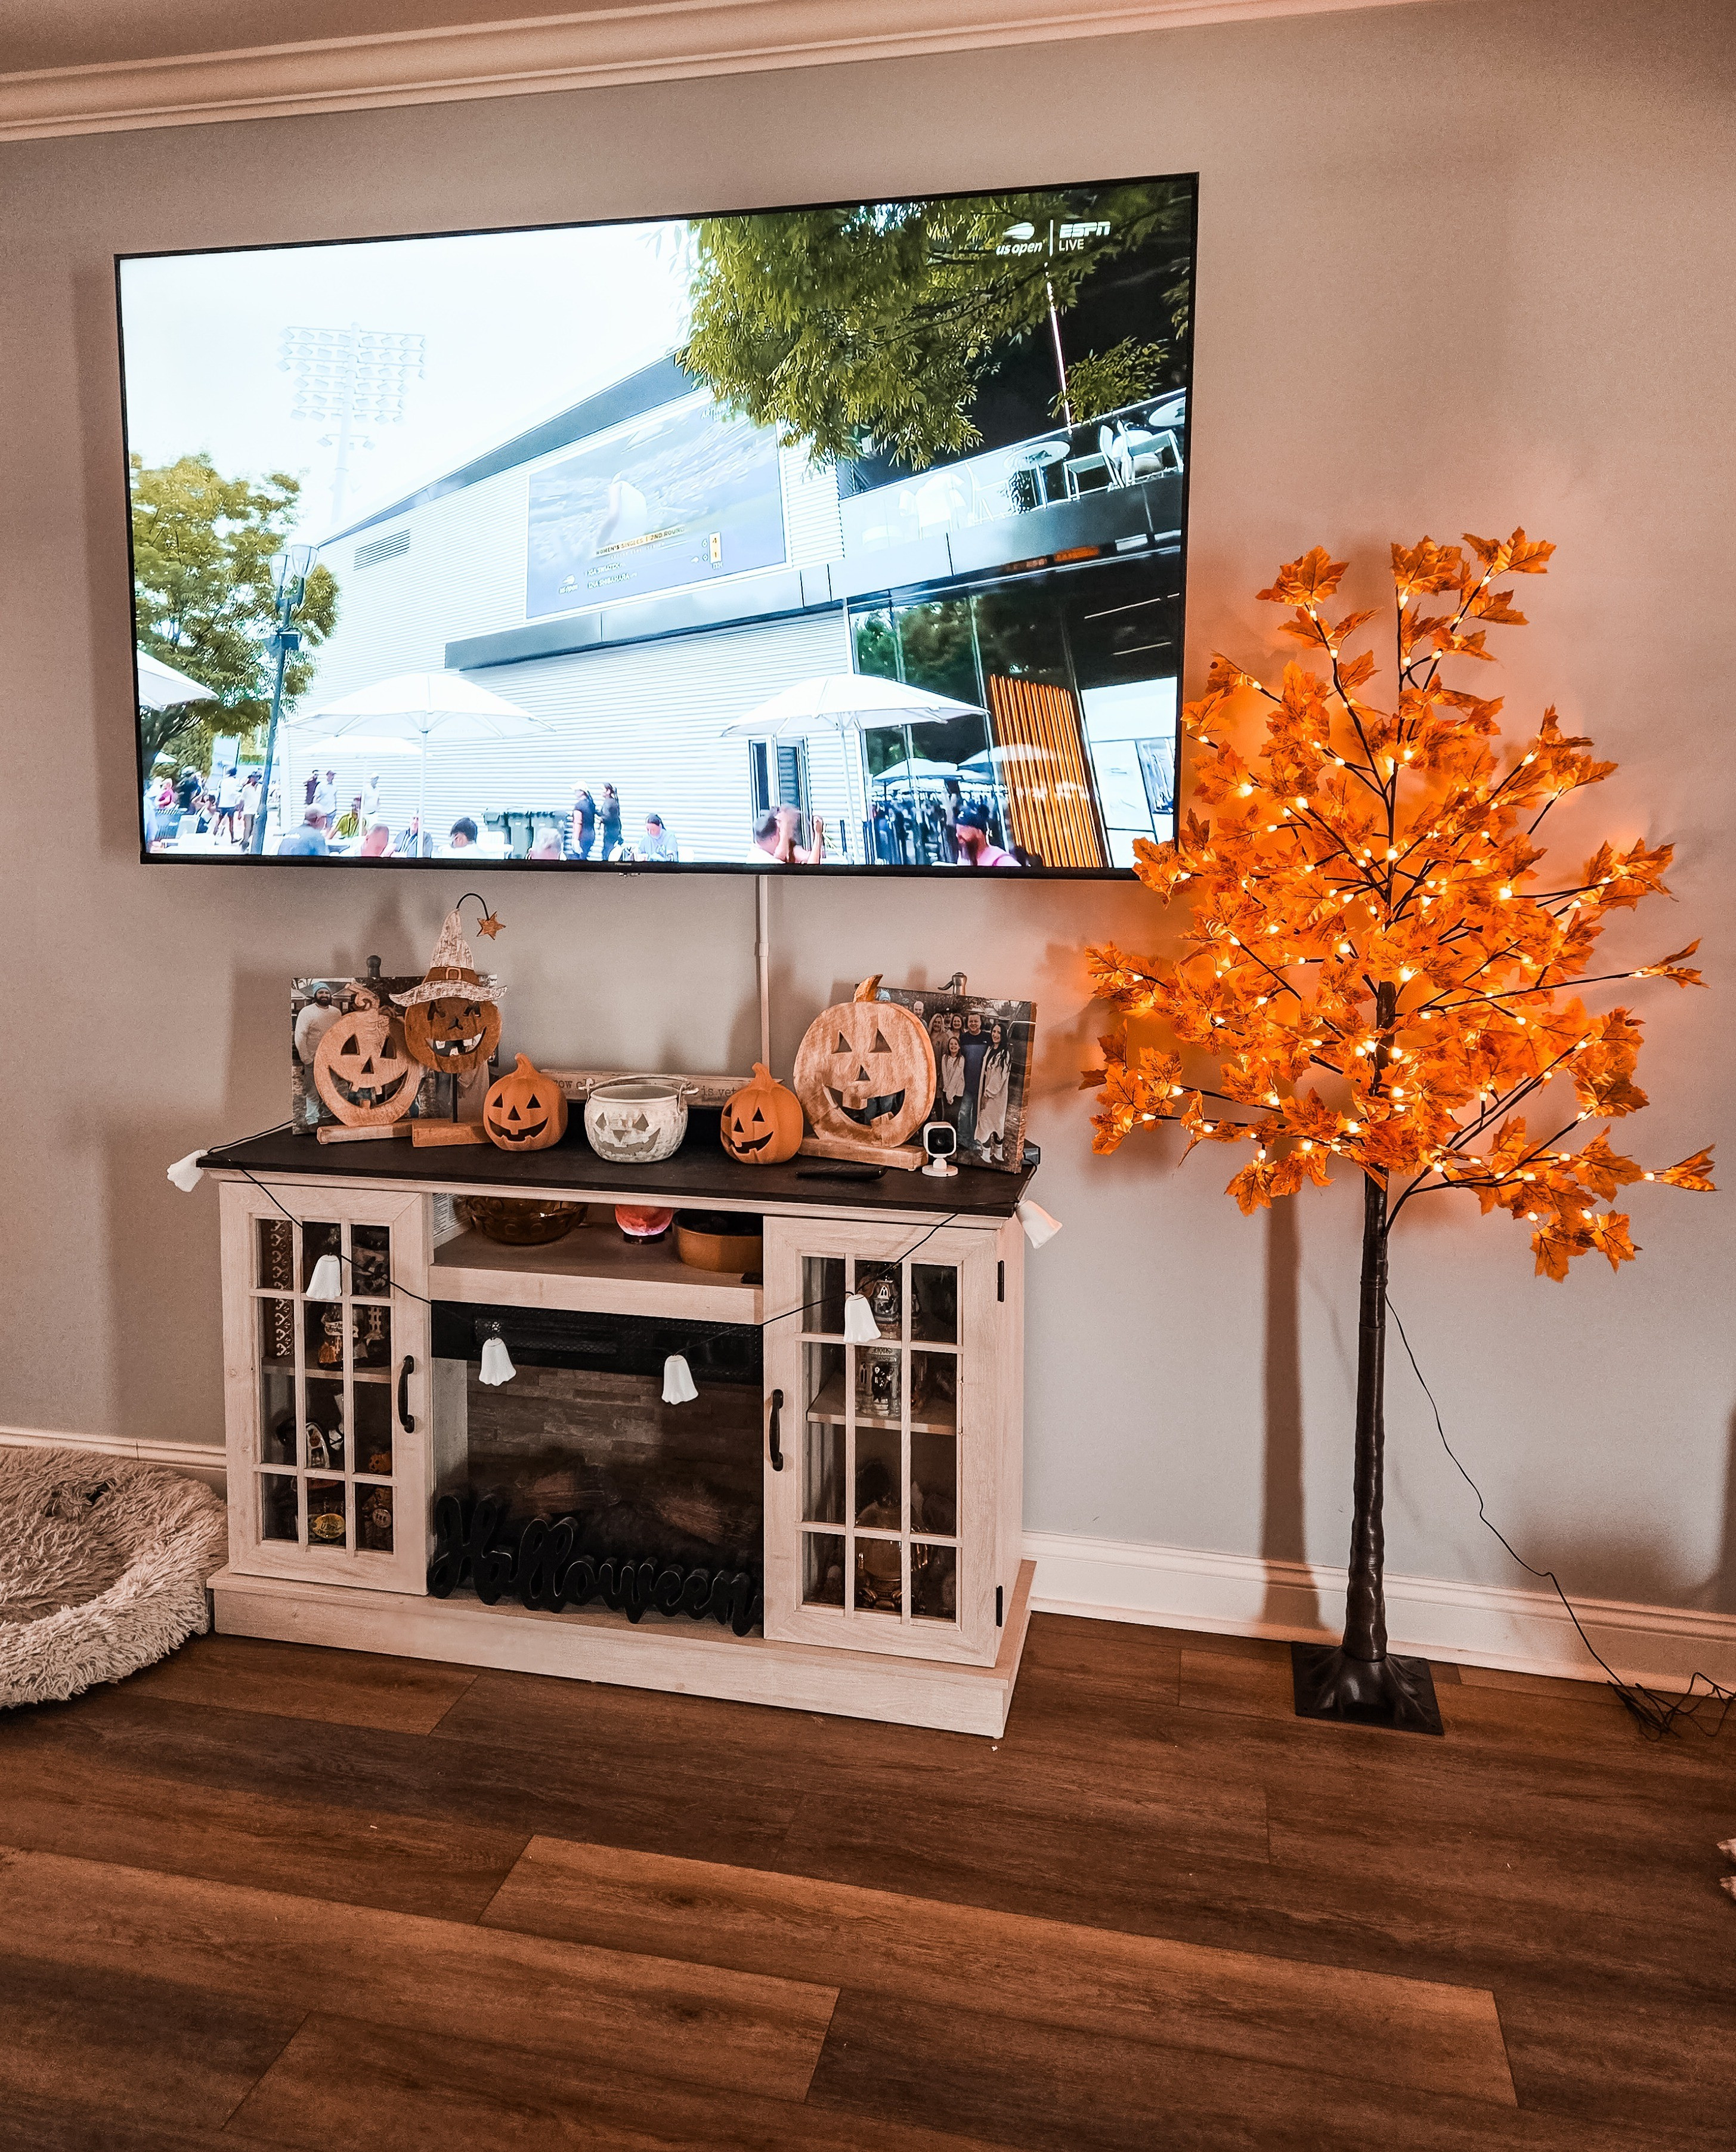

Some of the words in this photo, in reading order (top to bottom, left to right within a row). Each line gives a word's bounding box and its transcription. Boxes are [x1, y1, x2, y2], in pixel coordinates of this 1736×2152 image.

[1059, 221, 1111, 239] ESPN
[996, 244, 1011, 256] us
[1011, 242, 1042, 256] open
[1059, 239, 1084, 252] LIVE
[701, 1085, 714, 1097] is
[427, 1495, 763, 1637] Halloween
